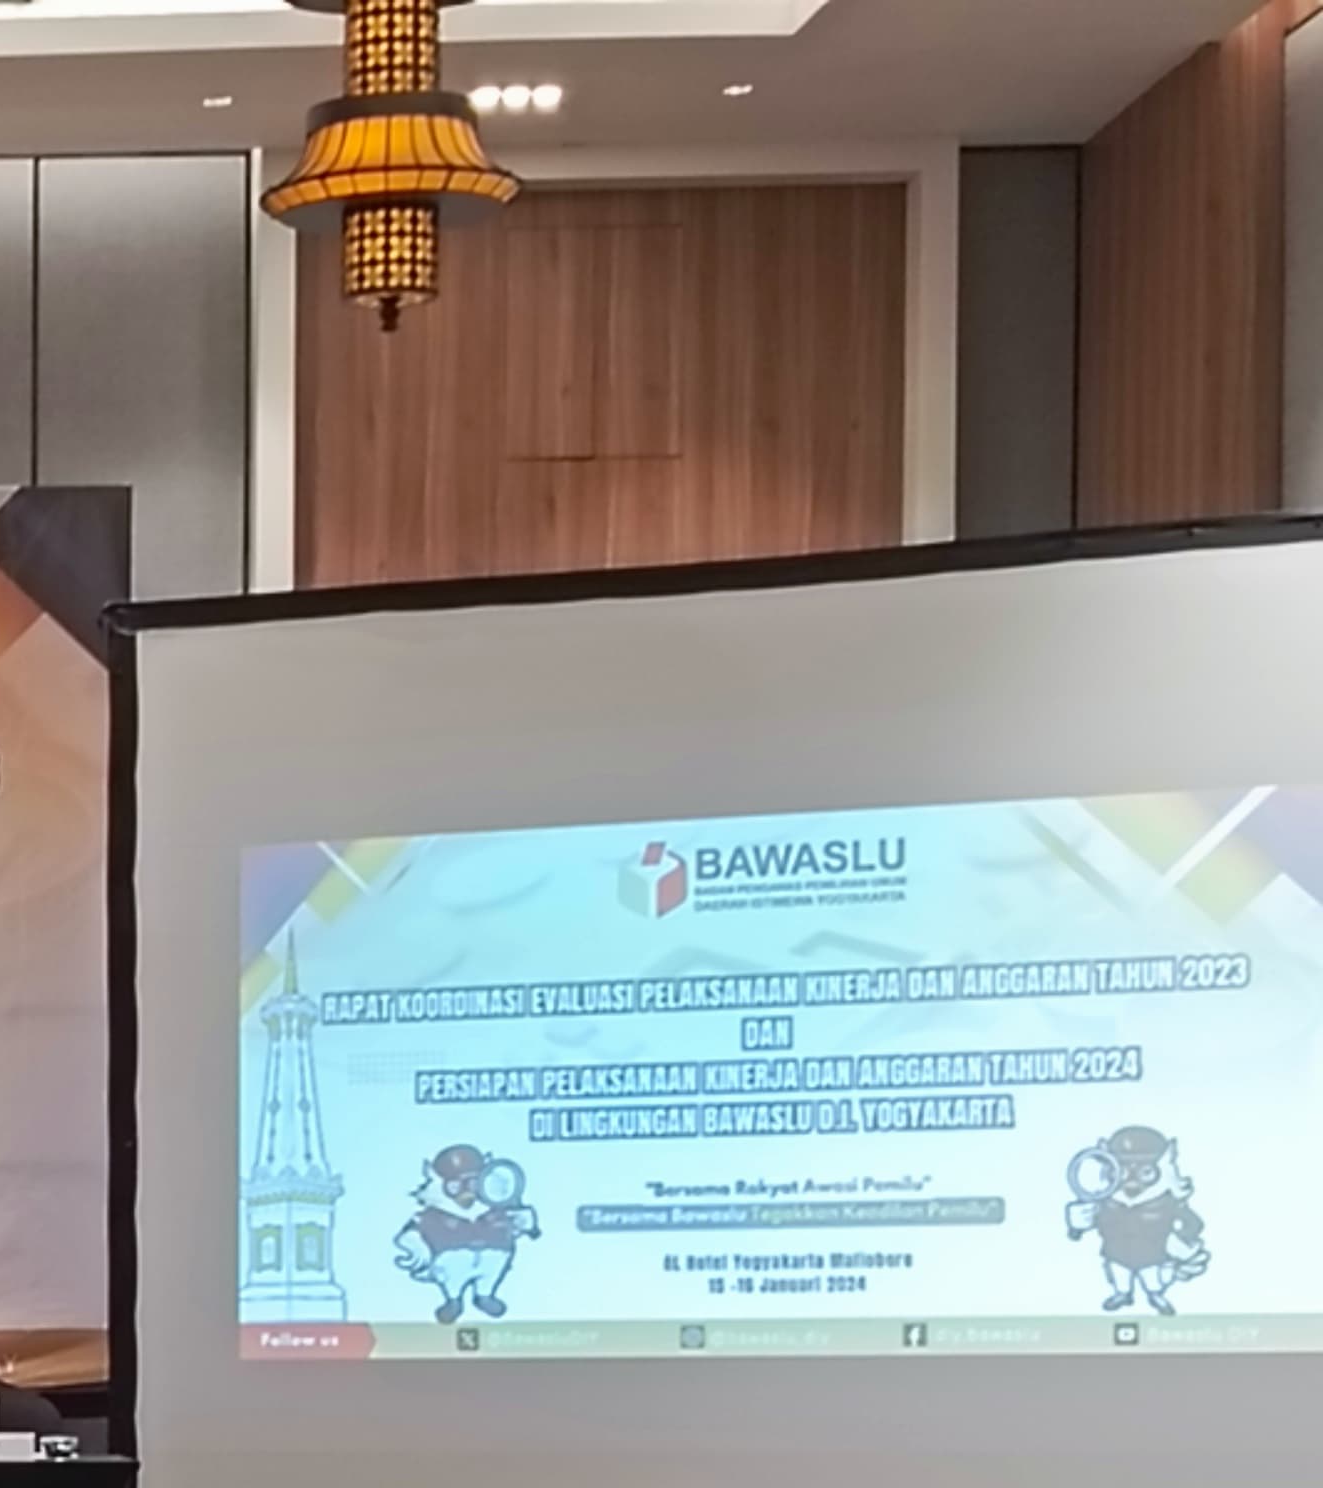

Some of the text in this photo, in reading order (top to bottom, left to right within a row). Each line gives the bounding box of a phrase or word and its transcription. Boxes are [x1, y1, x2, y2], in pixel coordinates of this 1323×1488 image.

[694, 837, 906, 880] BAWASLU
[694, 891, 906, 912] DAERAH ISTIMEWA YOGYAKARTA
[322, 956, 1248, 1024] RAPAT KOORDINASI EVALUASI PELAKSANAAN KINERJA DAN ANGGARAN TAHUN 2023
[743, 1018, 791, 1049] DAN
[416, 1048, 1141, 1101] PERSIAPAN PELAKSANAAN KINERJA DAN ANGGARAN TAHUN 2024
[530, 1096, 1013, 1140] DI LINGKUNGAN BAWASLU D.I. YOGYAKARTA
[735, 1178, 798, 1198] Rakyat
[803, 1178, 858, 1194] Awasi
[671, 1206, 747, 1223] Bawaslu
[686, 1254, 728, 1271] Hotel
[733, 1253, 824, 1272] Yogyakarta
[829, 1252, 913, 1269] Malioboro
[708, 1277, 725, 1294] 15
[759, 1276, 822, 1293] Januari
[826, 1275, 867, 1292] 2024
[260, 1333, 339, 1348] Follow us
